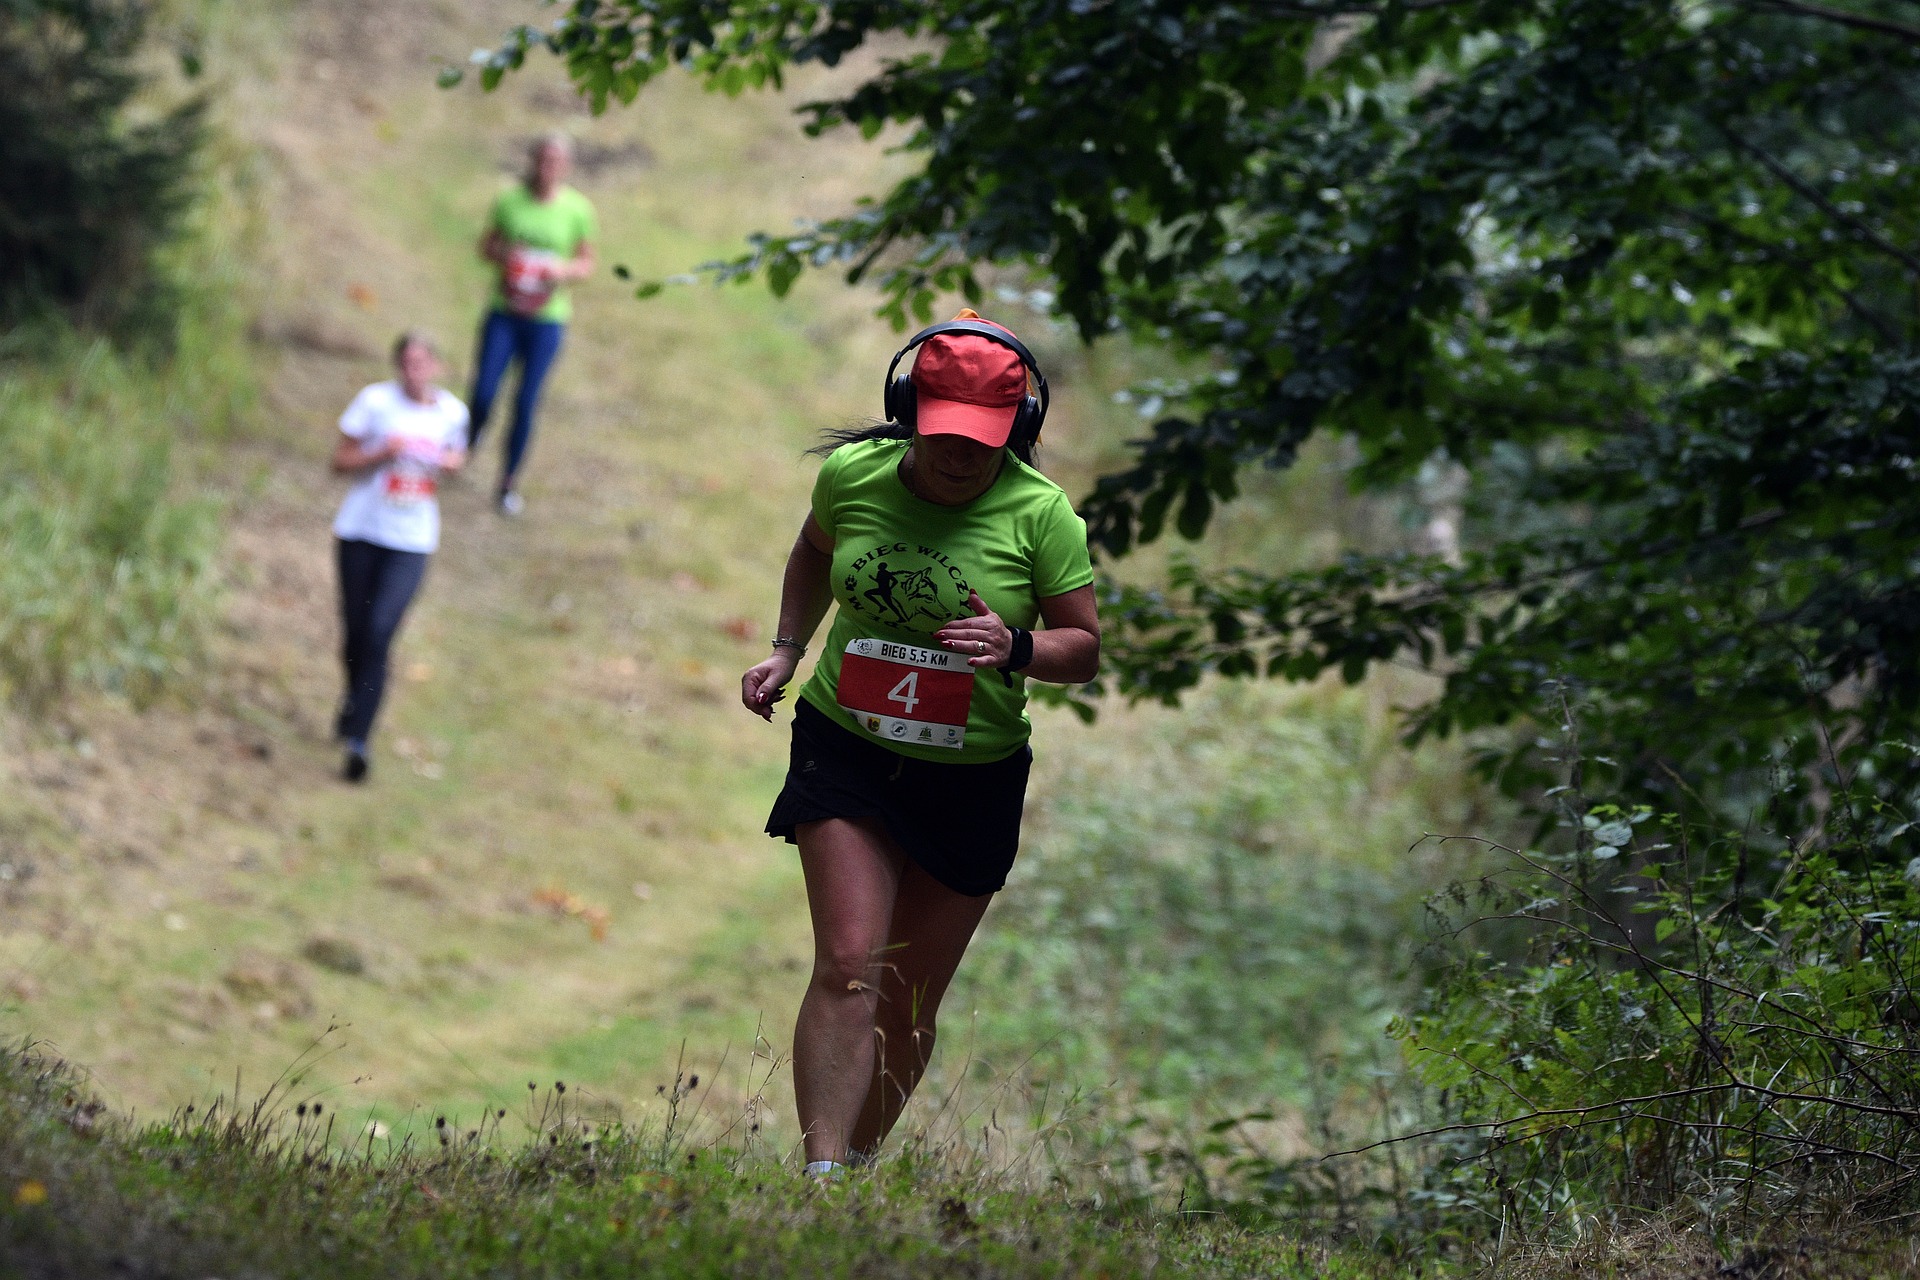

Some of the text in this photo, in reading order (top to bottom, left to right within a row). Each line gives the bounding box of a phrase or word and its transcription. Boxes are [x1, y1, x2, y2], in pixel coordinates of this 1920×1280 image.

[851, 542, 908, 573] BIEG
[881, 643, 906, 660] BIEG
[909, 648, 928, 664] 5,5
[930, 653, 949, 667] KM
[887, 671, 920, 714] 4
